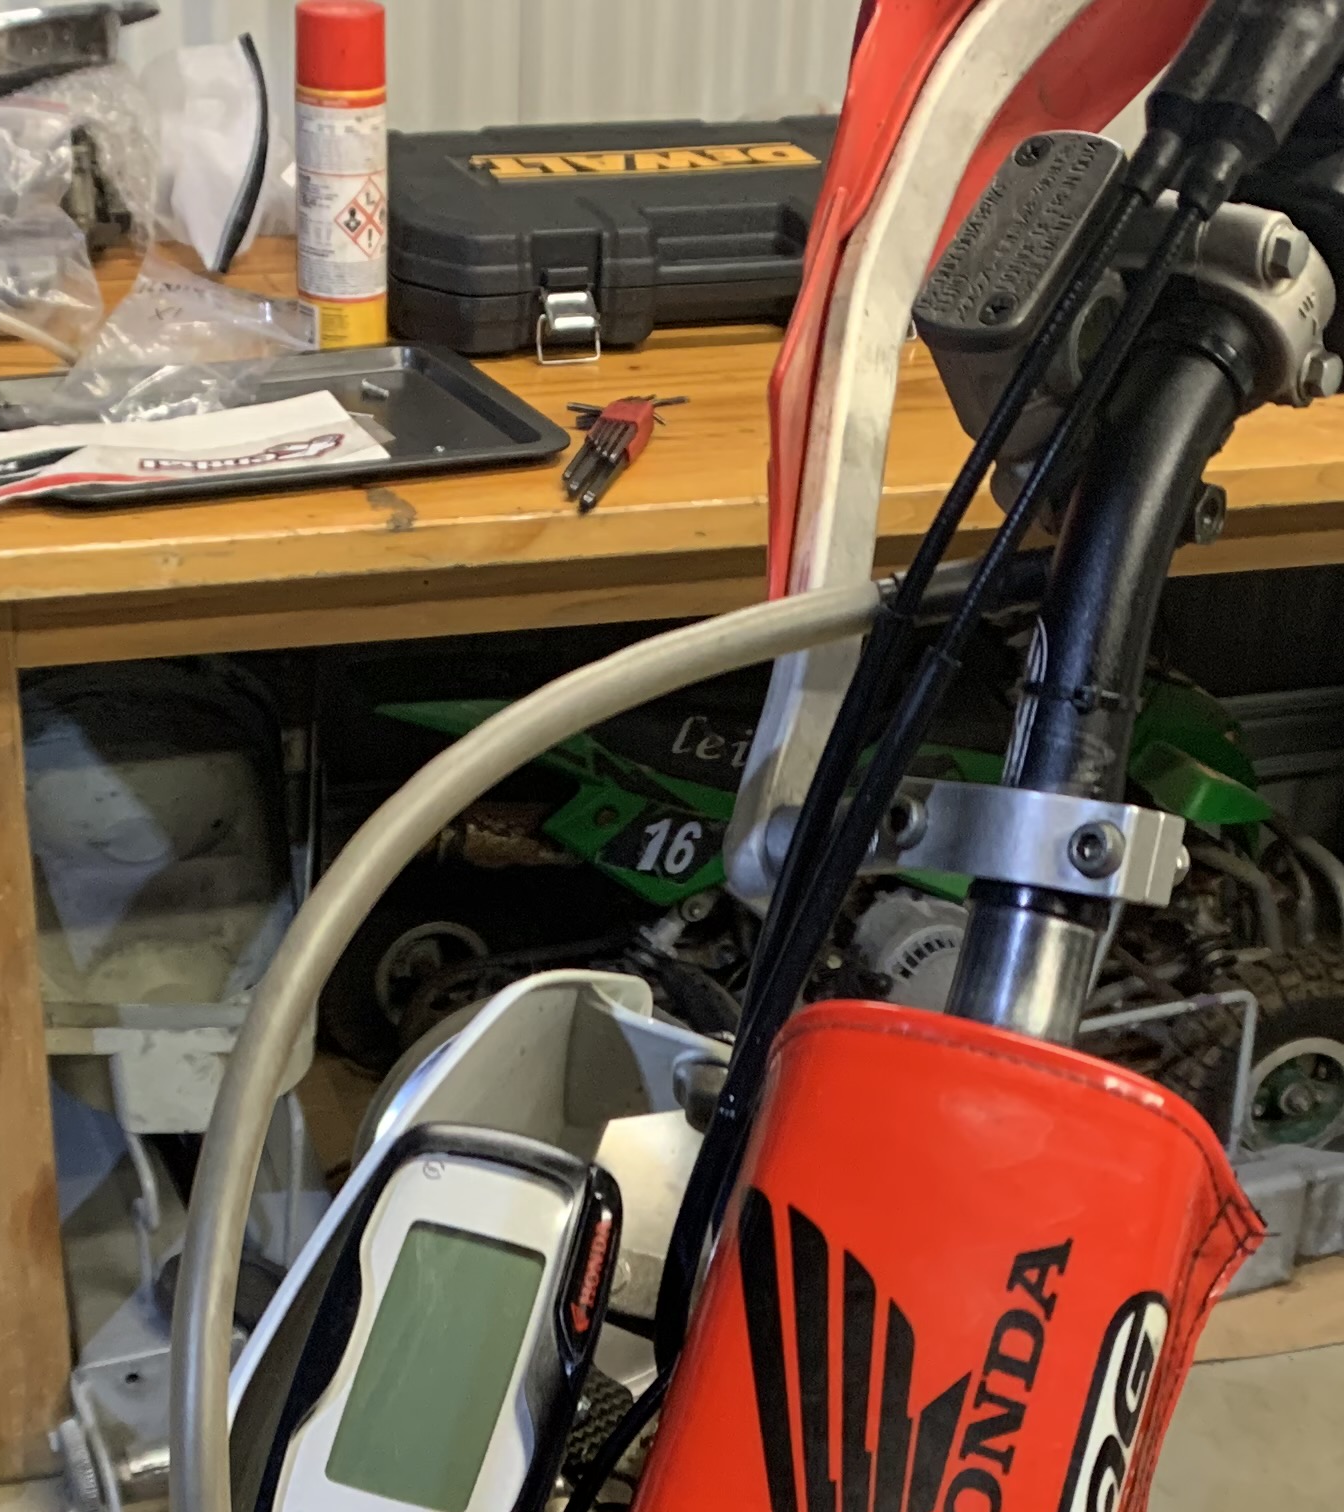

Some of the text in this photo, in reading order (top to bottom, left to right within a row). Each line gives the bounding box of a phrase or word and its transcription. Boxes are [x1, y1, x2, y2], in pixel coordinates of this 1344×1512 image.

[469, 143, 820, 181] DEWALT
[636, 818, 702, 875] 16
[578, 1219, 613, 1309] HONDA
